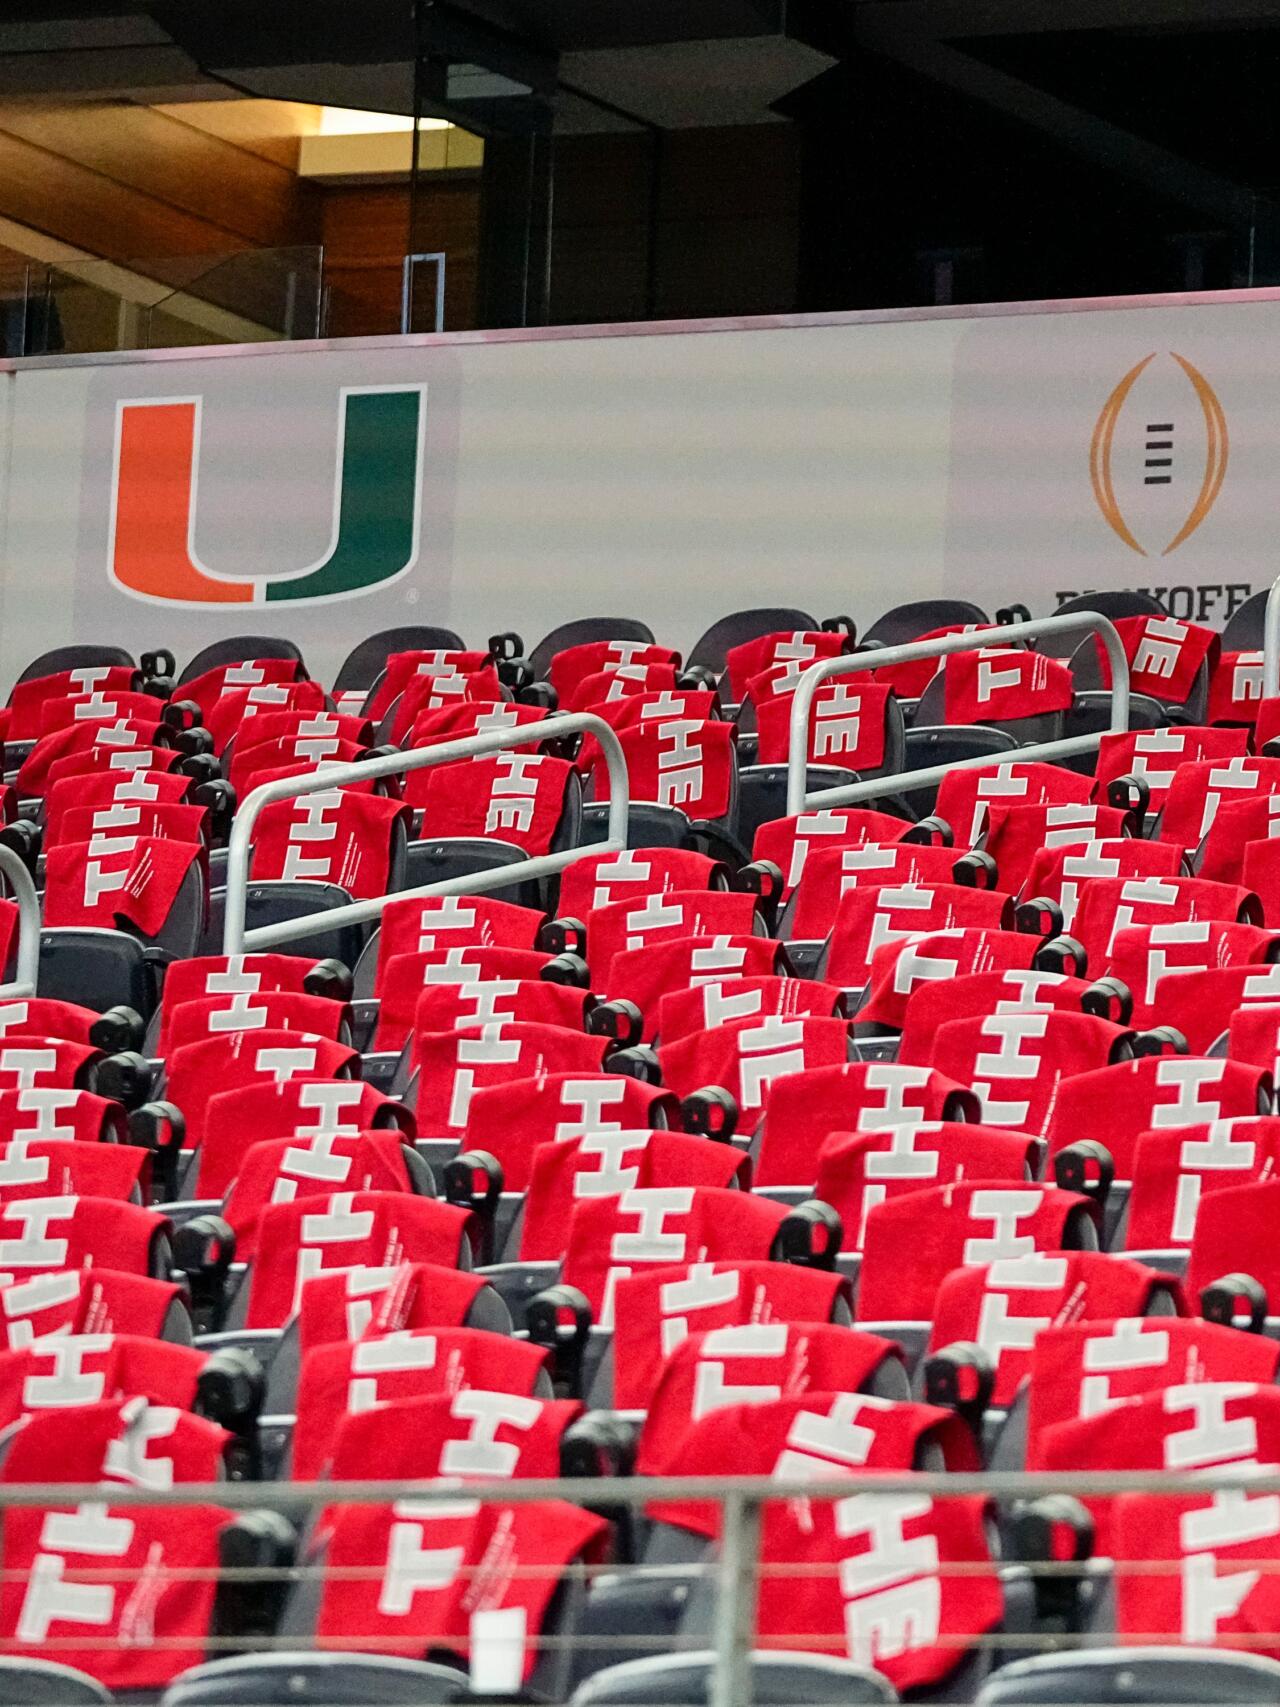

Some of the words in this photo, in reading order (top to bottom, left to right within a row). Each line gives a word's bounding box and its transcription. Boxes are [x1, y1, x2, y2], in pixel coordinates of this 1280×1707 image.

[108, 383, 427, 610] U
[485, 754, 546, 834] HE
[658, 719, 704, 805] HE
[282, 790, 344, 881] TH
[836, 1494, 942, 1664] HE
